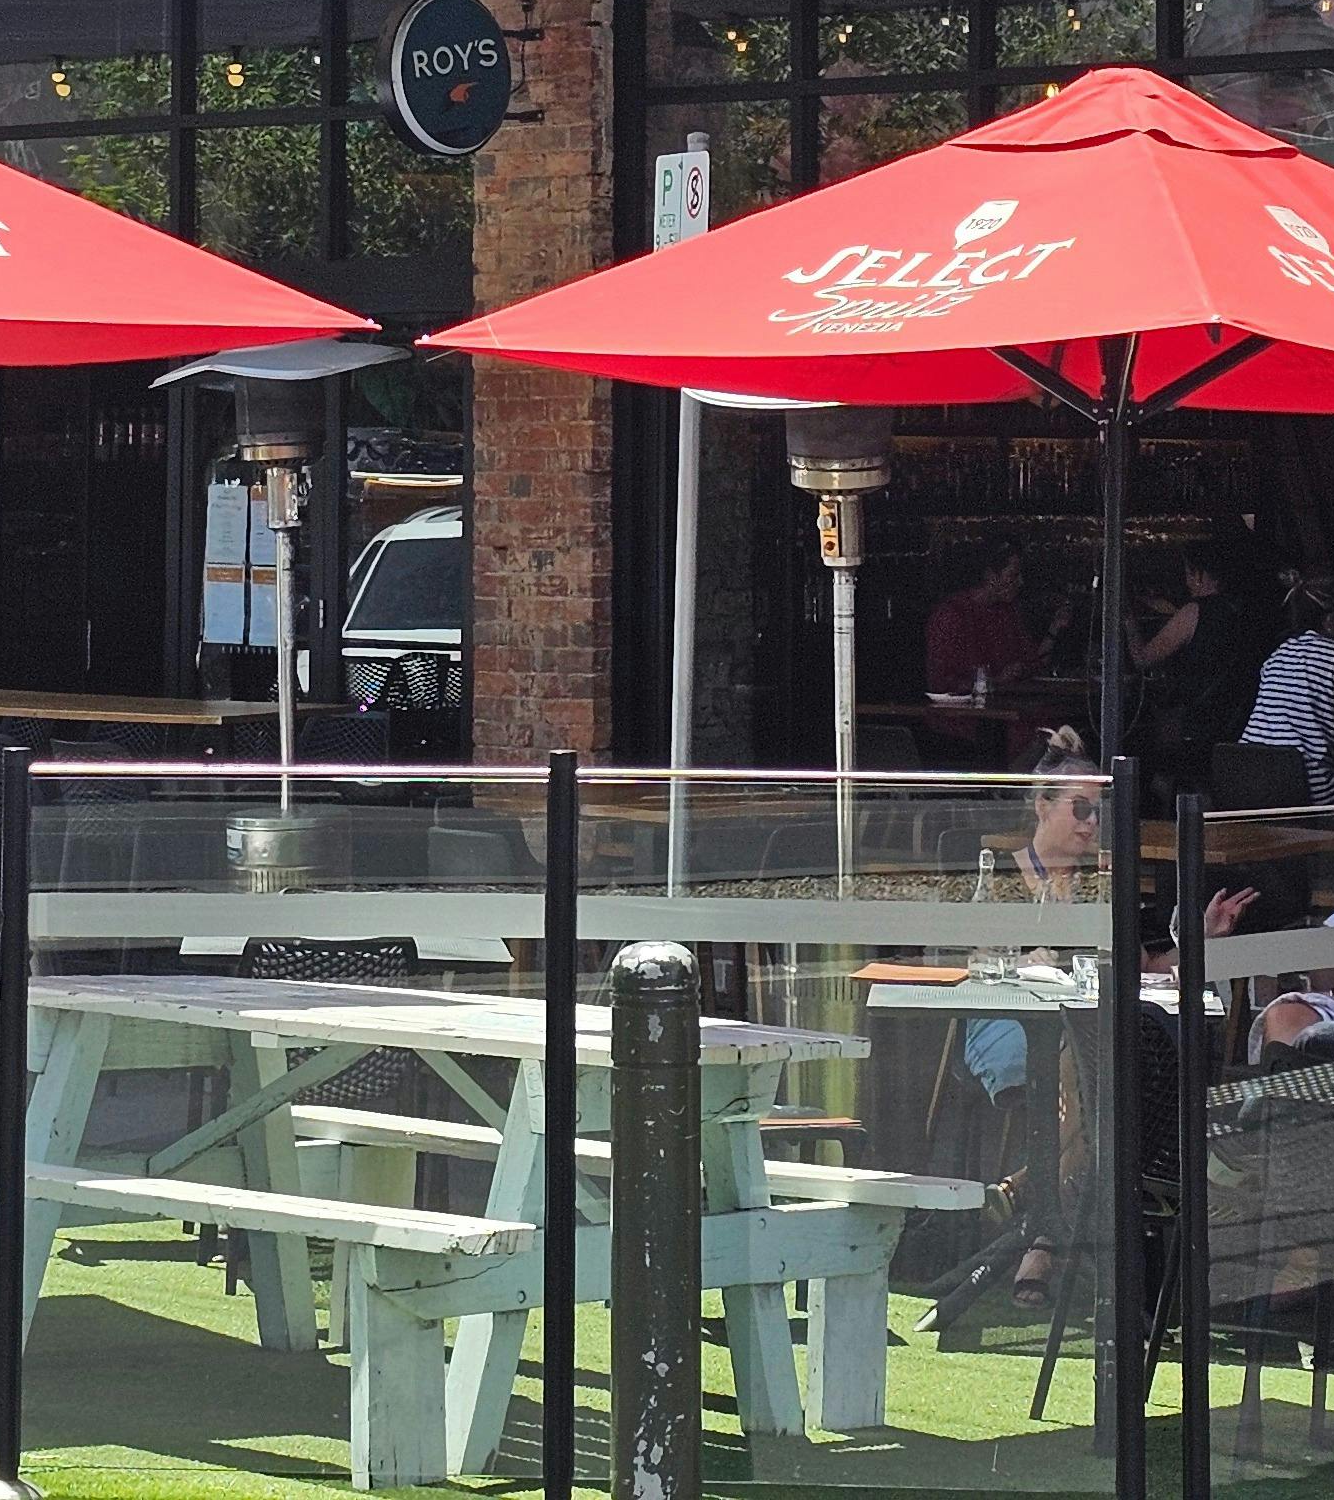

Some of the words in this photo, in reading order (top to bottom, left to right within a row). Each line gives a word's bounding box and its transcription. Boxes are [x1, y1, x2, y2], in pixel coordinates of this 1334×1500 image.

[412, 38, 498, 78] ROY'S
[780, 236, 1076, 288] SELECT
[811, 320, 904, 334] VENEZIA
